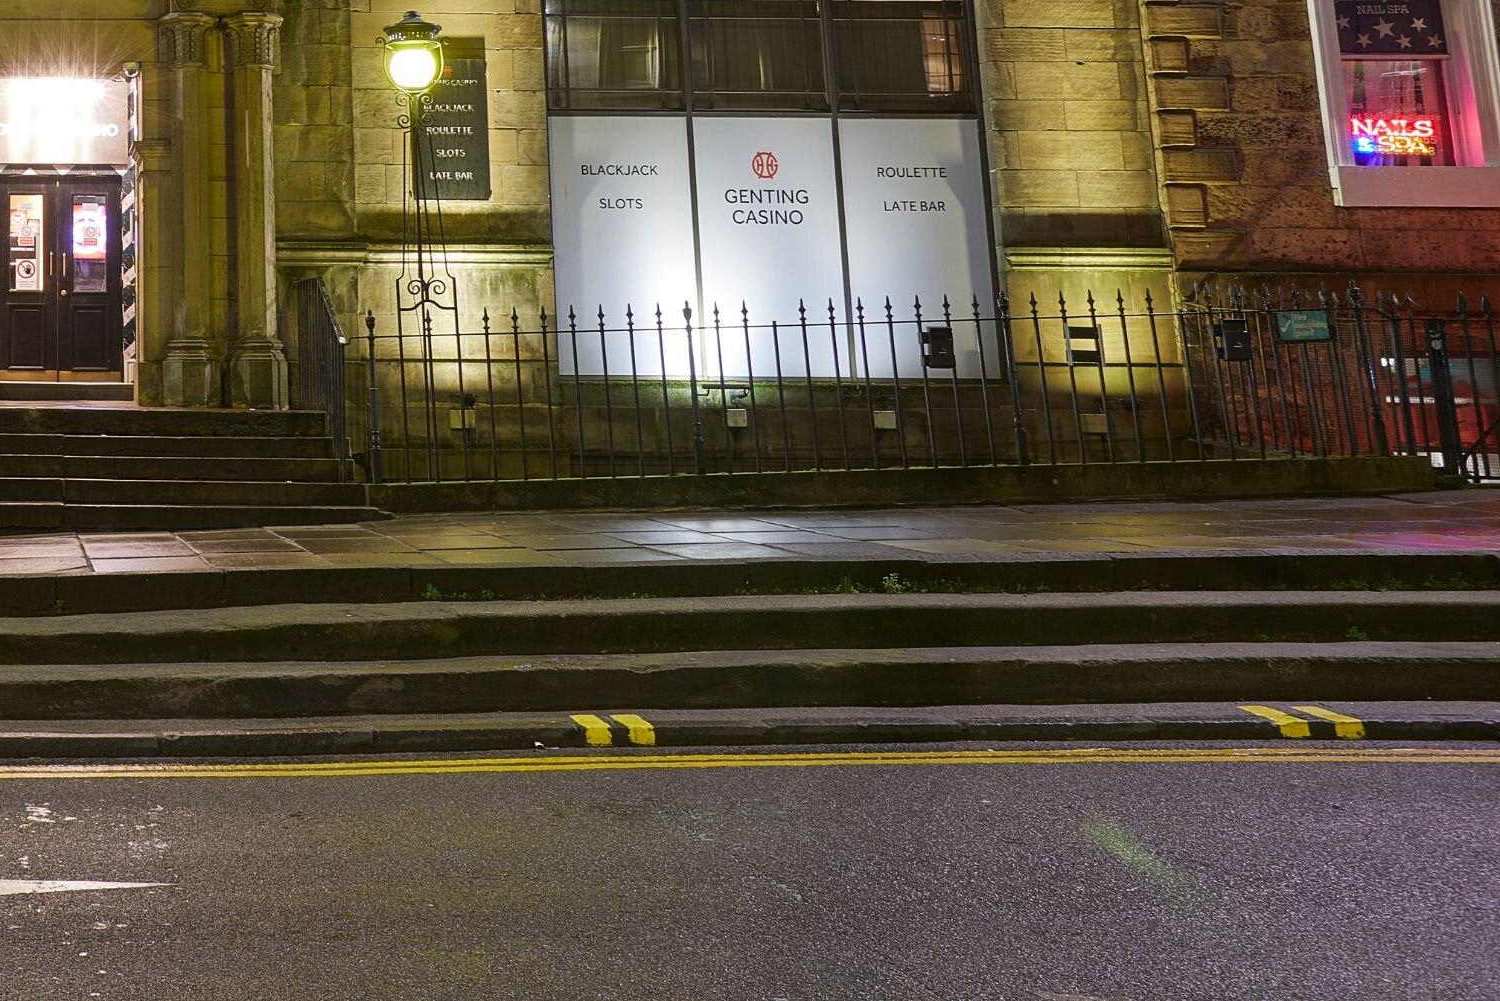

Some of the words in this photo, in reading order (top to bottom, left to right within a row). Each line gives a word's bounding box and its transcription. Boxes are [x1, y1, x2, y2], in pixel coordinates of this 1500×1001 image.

[1357, 5, 1385, 15] NAIL
[1387, 4, 1410, 14] SPA
[423, 104, 475, 112] BLACKJACK
[426, 126, 474, 135] ROULETTE
[1350, 118, 1434, 137] NAILS
[436, 148, 466, 158] SLOTS
[429, 170, 452, 180] LATE
[455, 171, 473, 180] BAR
[580, 164, 659, 176] BLACKJACK
[876, 166, 948, 179] ROULETTE
[724, 189, 809, 204] GENTING
[599, 197, 643, 210] SLOTS
[883, 200, 917, 212] LATE
[919, 201, 946, 212] BAR
[731, 209, 804, 225] CASINO
